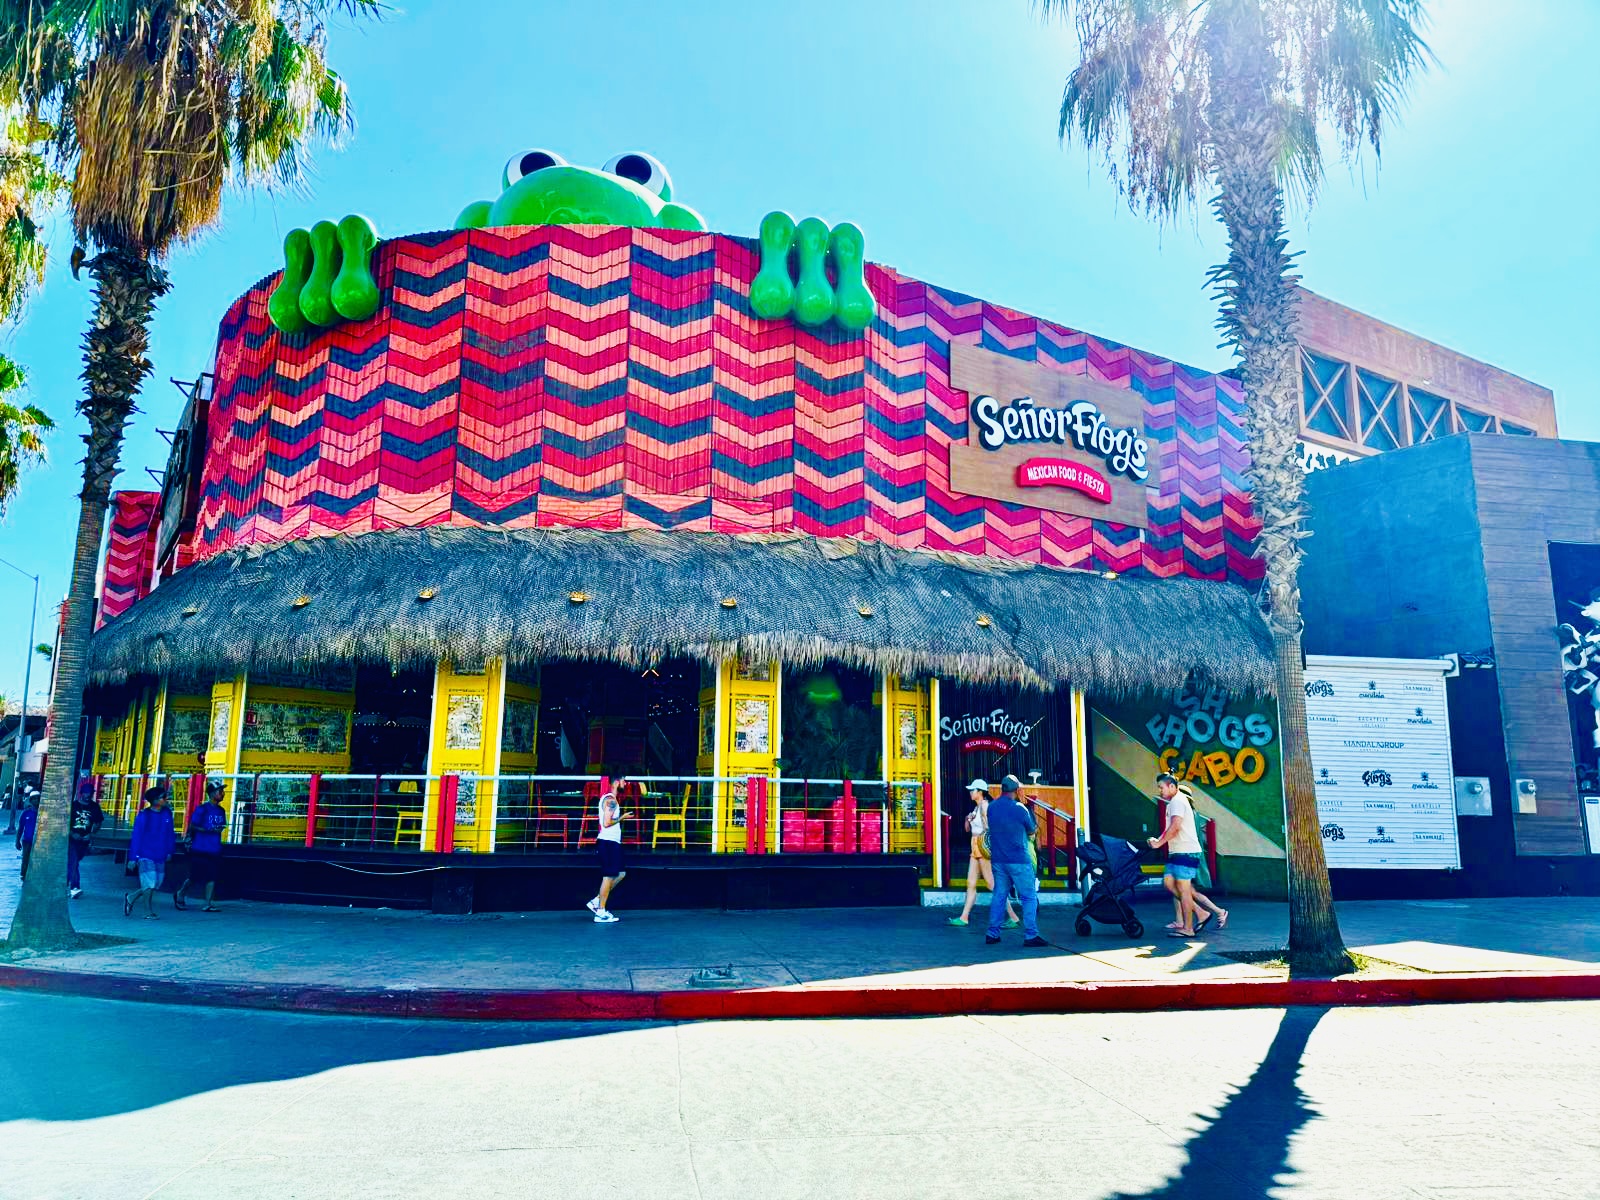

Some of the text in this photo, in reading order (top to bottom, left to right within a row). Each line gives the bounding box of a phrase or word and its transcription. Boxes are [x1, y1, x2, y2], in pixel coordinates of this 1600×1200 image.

[974, 396, 1149, 480] Señor Frog's
[1027, 465, 1105, 495] MEXICAN FOOD & FIESTA
[940, 708, 1031, 747] Señor Frog's
[1145, 711, 1273, 749] FROGS
[1159, 747, 1265, 788] CABO
